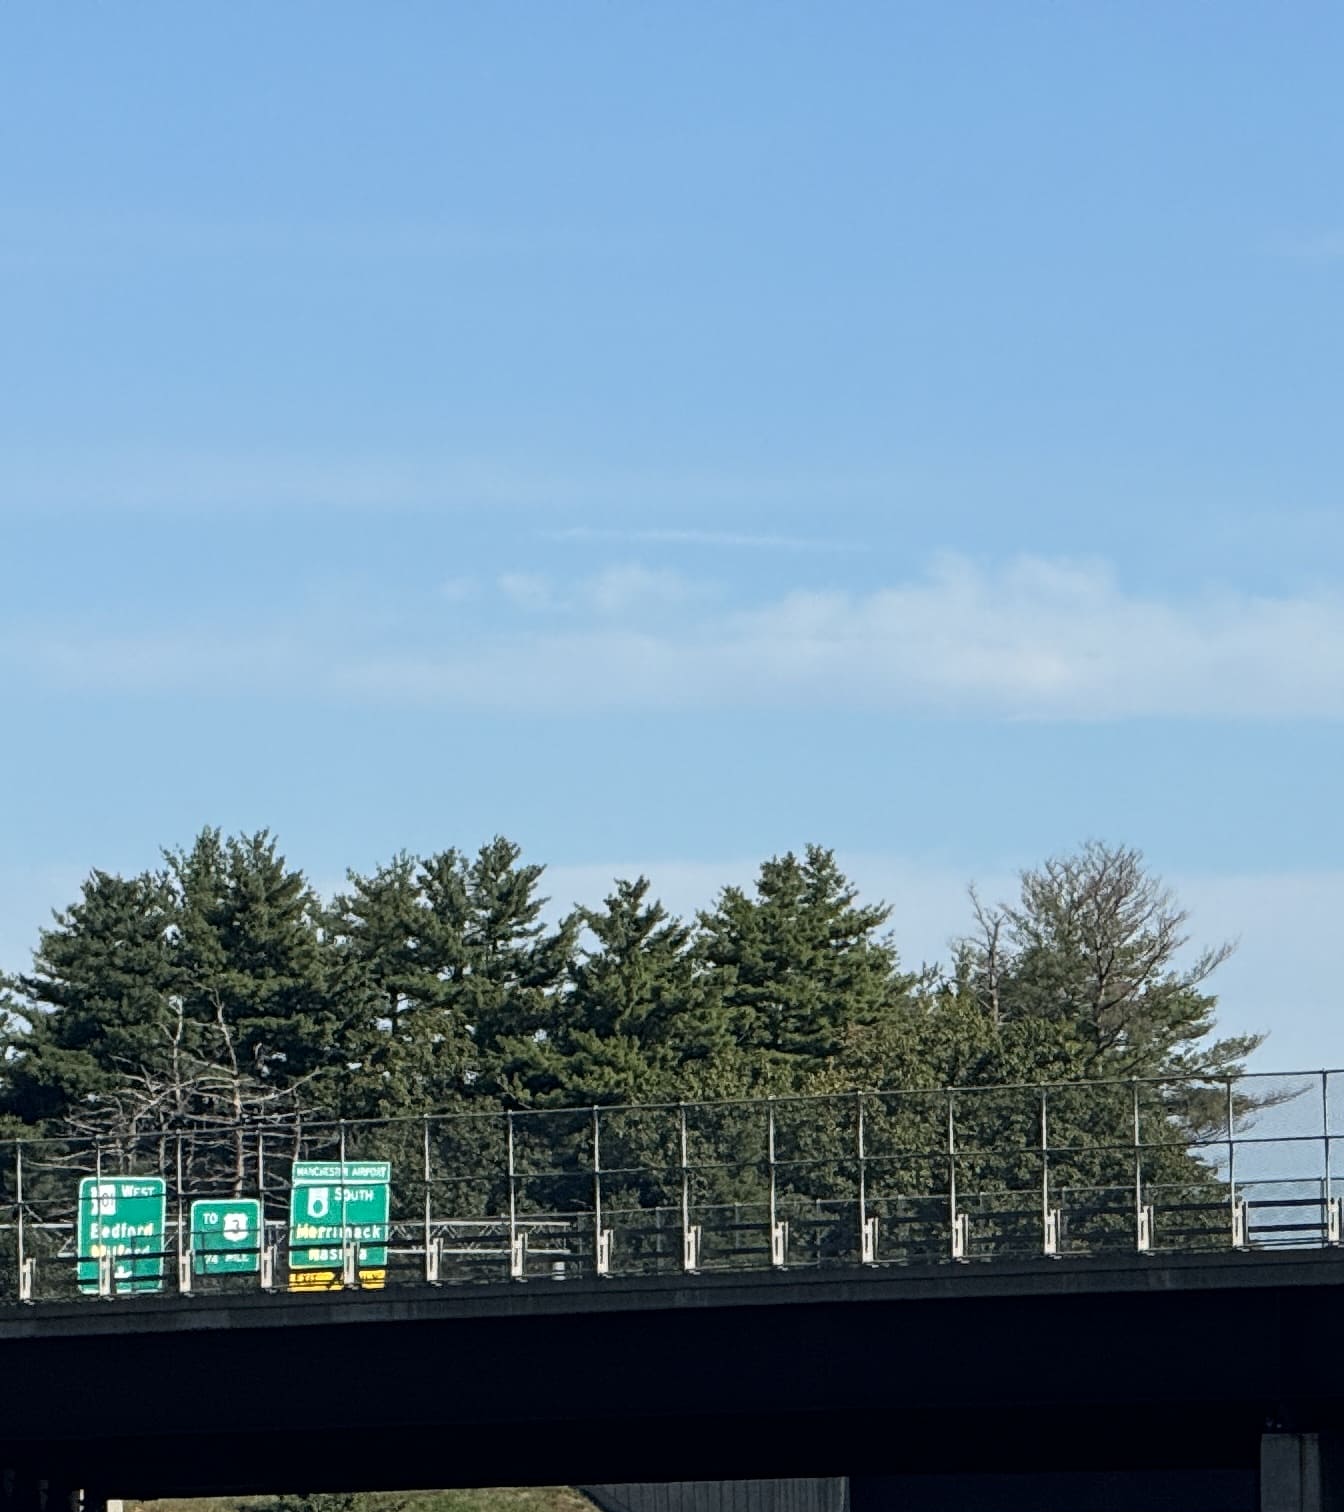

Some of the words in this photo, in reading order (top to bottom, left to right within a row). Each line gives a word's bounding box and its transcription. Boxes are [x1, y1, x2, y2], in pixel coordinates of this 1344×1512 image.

[121, 1185, 156, 1198] WEST
[333, 1187, 375, 1202] SOUTH
[203, 1212, 218, 1225] TO
